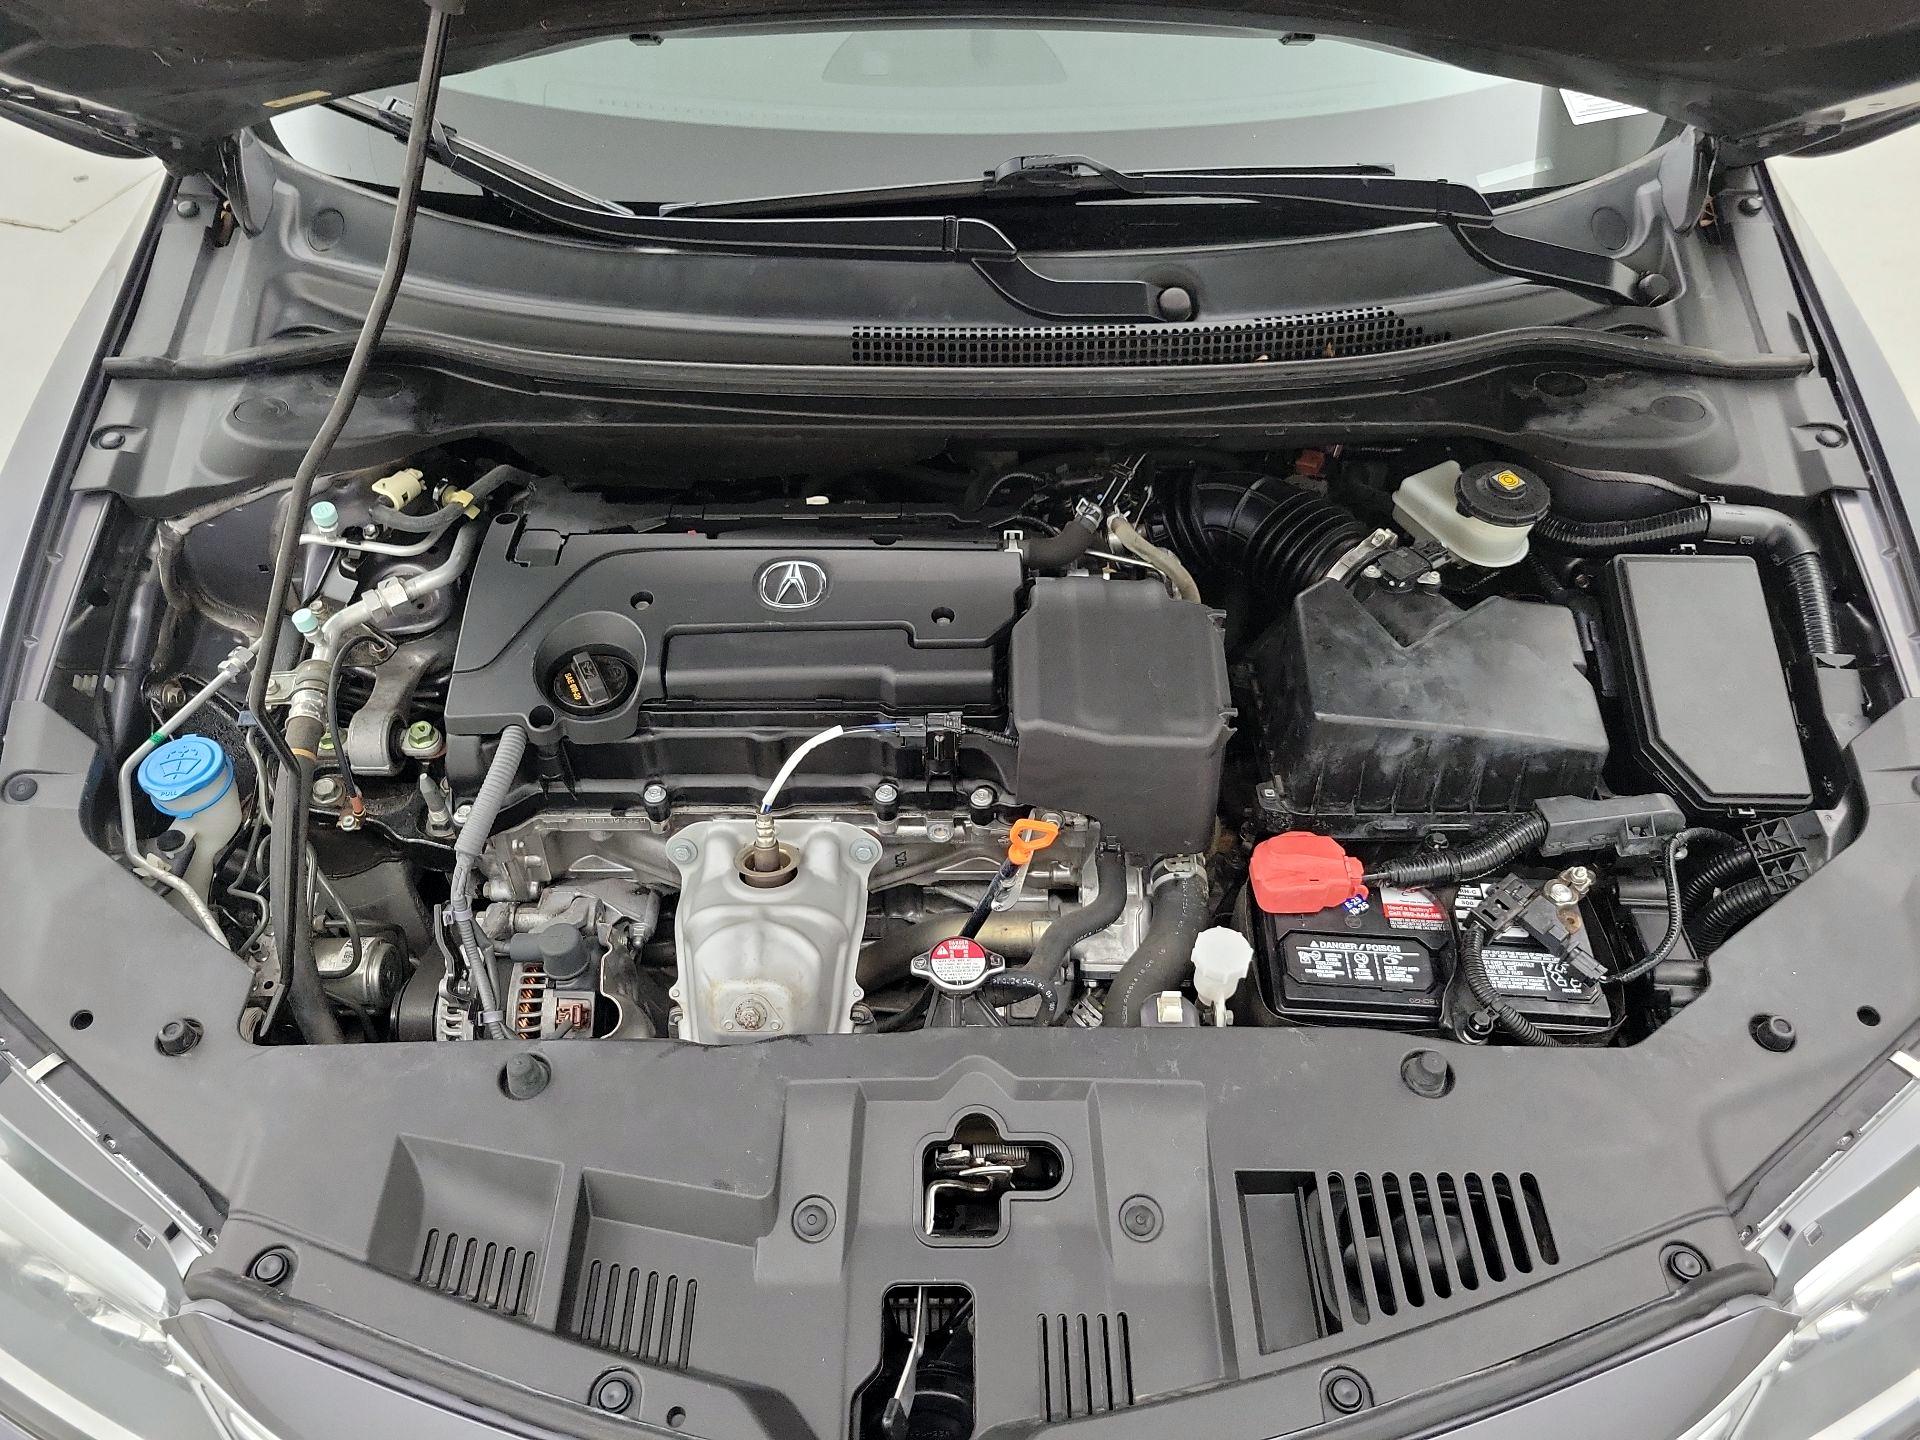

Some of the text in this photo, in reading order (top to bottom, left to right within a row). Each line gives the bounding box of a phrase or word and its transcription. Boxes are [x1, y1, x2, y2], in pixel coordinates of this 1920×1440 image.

[564, 673, 575, 684] SAE
[1387, 904, 1403, 912] Need
[1410, 906, 1433, 914] battery?
[1320, 941, 1358, 950] DANGER
[1366, 943, 1401, 953] POISON
